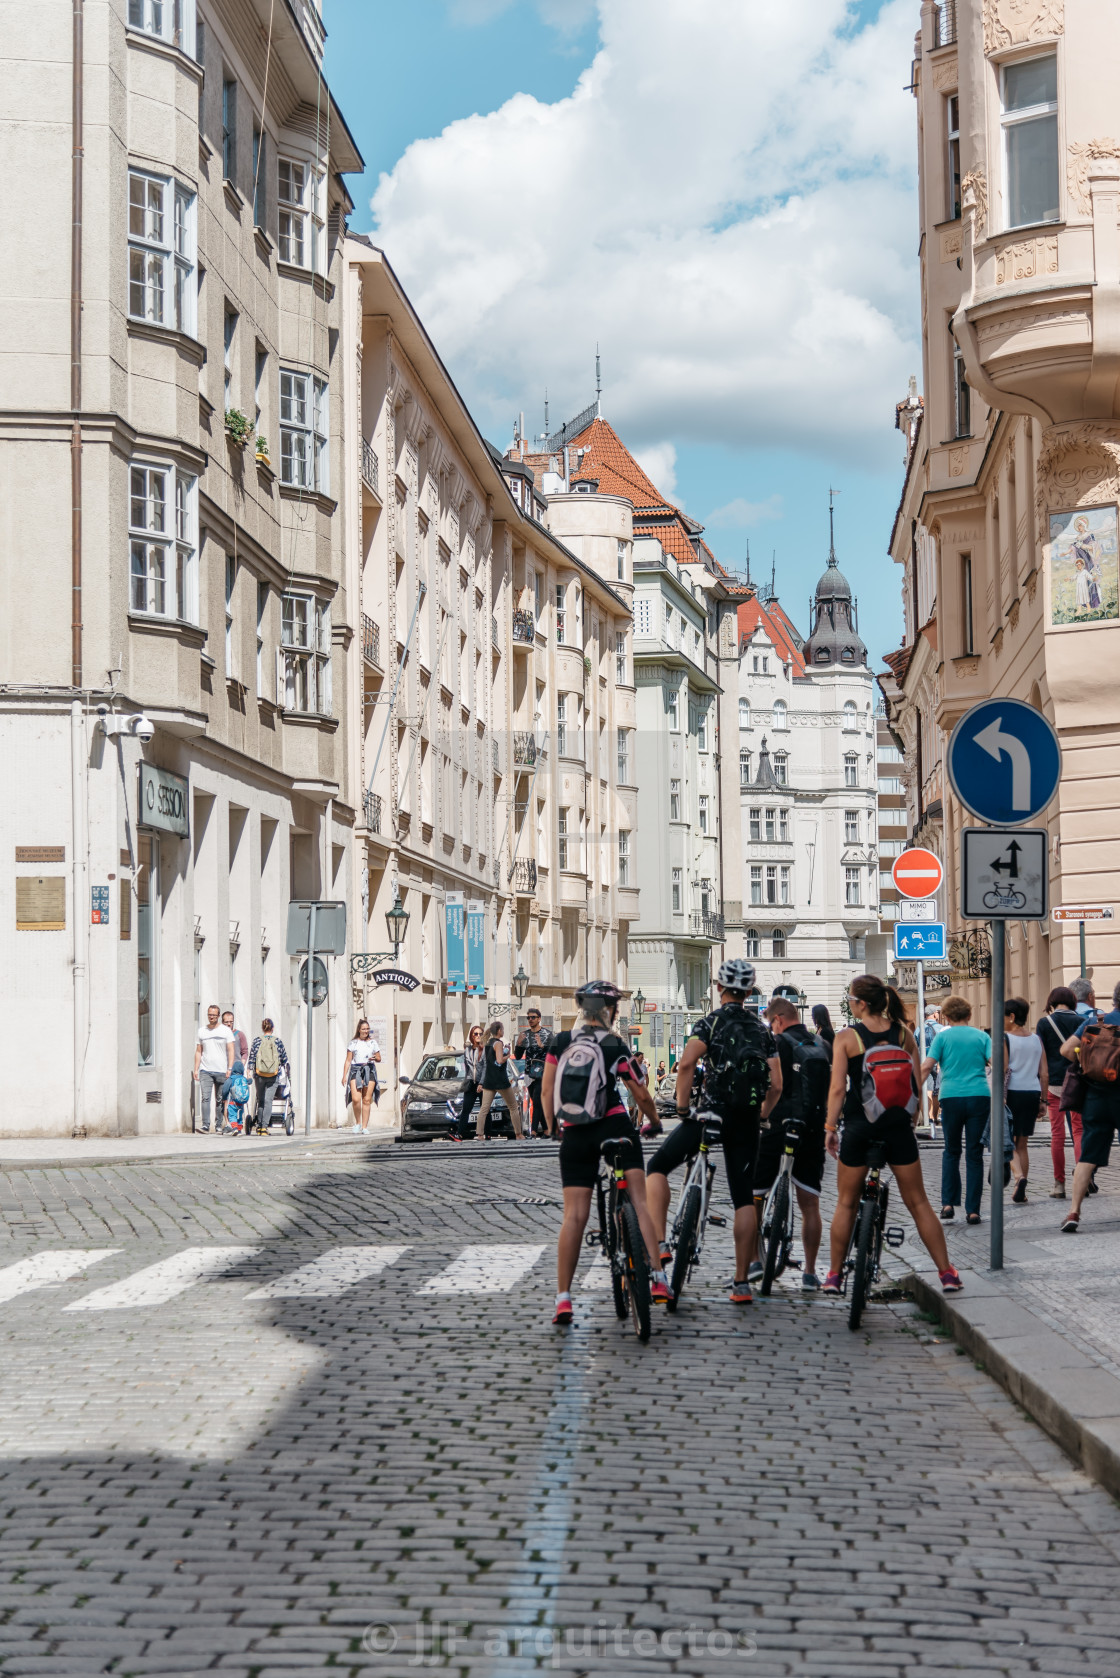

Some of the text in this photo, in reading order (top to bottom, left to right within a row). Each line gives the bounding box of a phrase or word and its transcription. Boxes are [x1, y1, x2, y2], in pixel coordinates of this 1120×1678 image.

[146, 779, 187, 820] O SESSION
[926, 960, 950, 968] SHOES
[375, 973, 417, 989] ANTIQUE
